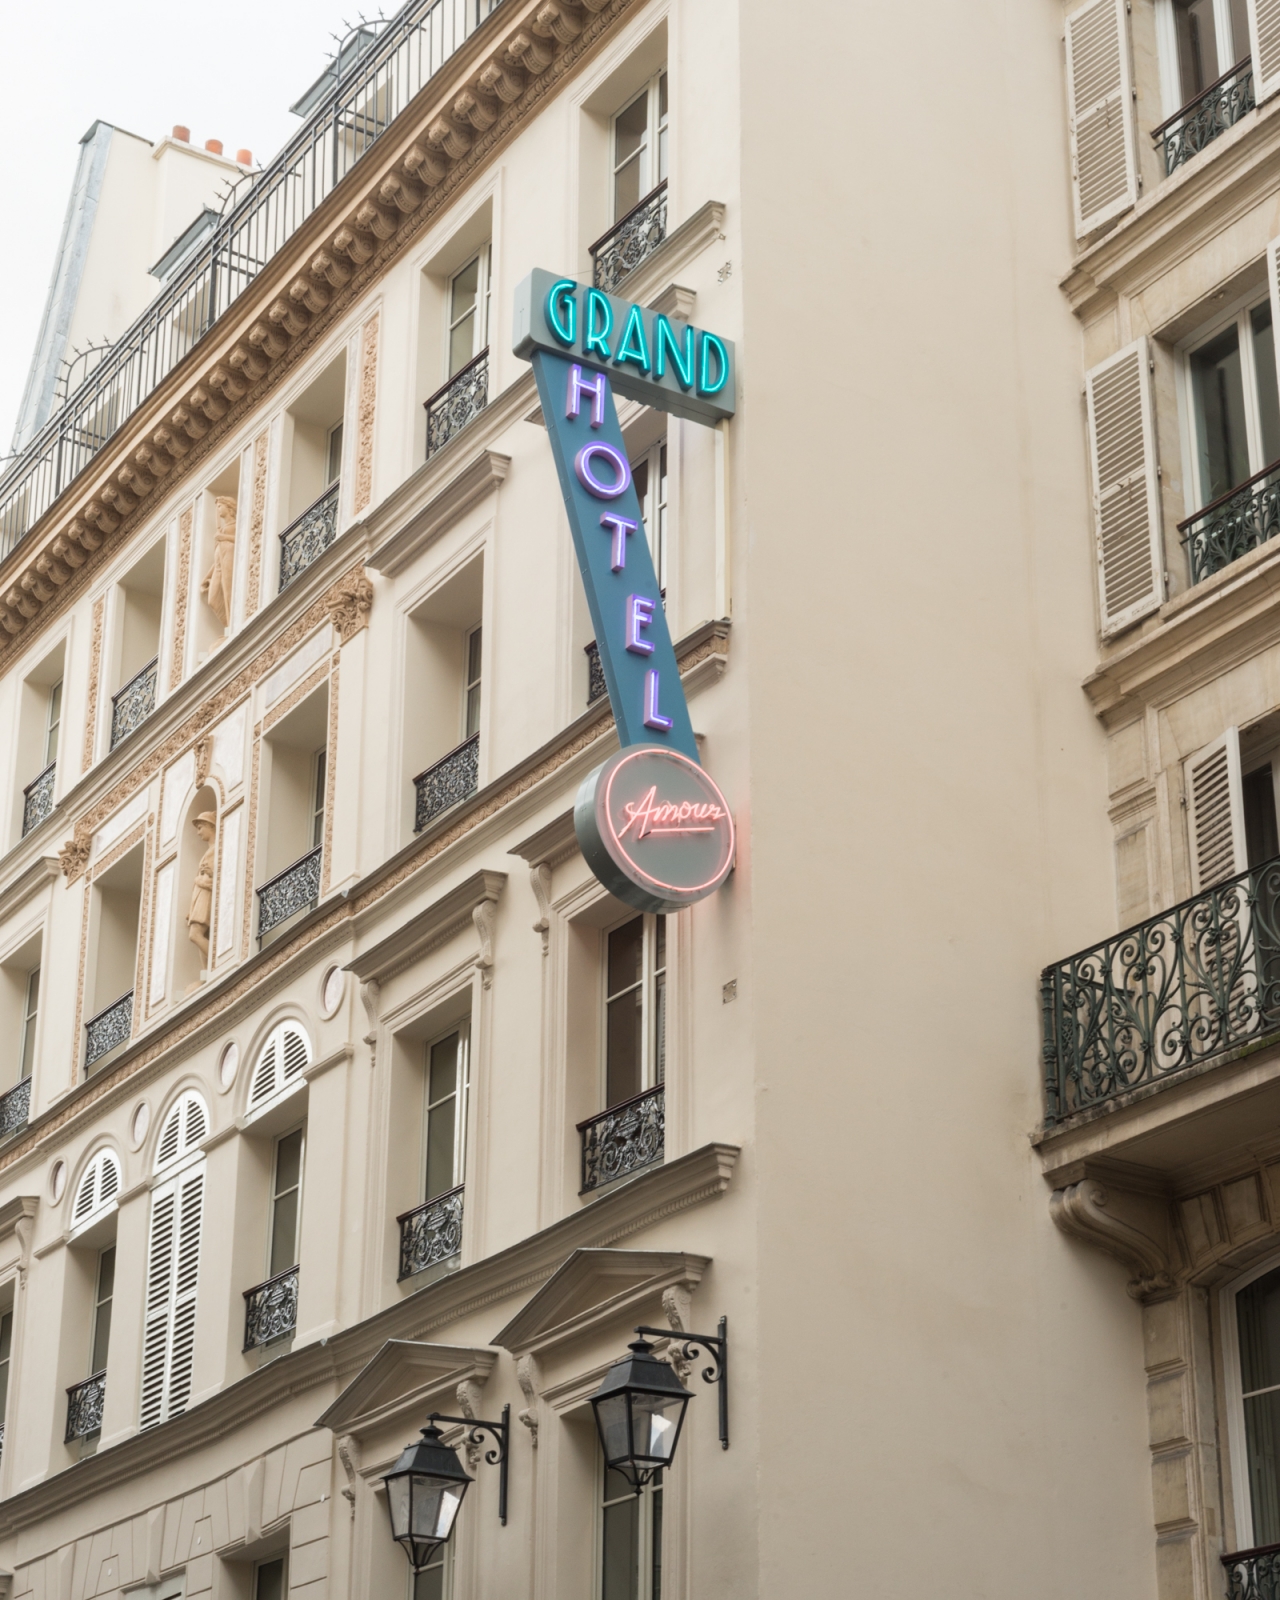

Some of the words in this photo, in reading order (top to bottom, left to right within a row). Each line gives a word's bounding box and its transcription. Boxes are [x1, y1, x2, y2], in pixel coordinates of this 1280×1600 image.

[544, 279, 729, 397] GRAND
[565, 363, 674, 732] HOTEL
[618, 785, 726, 839] Amour
